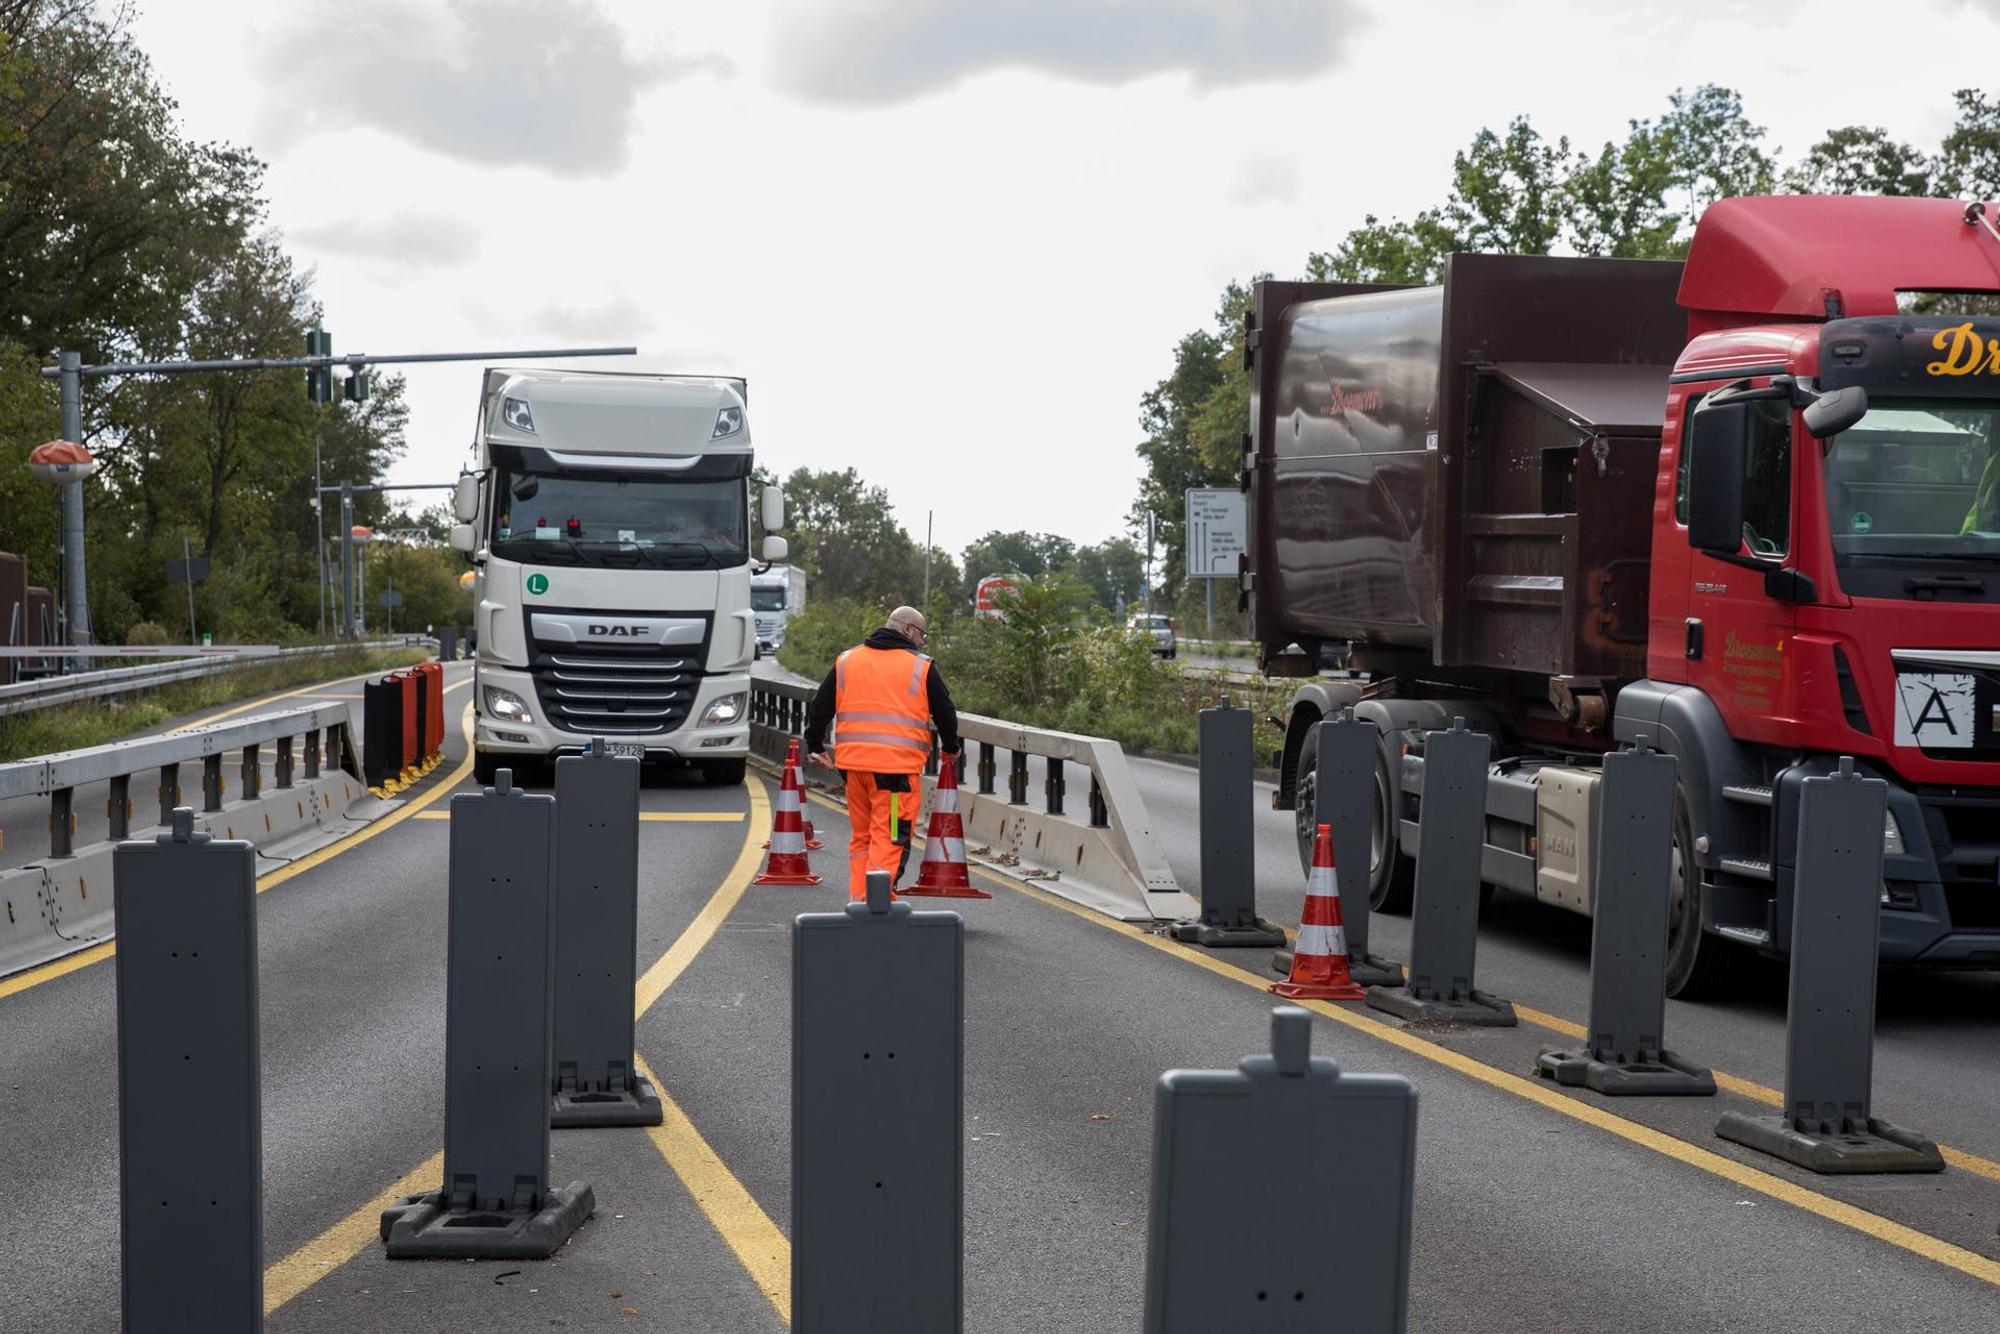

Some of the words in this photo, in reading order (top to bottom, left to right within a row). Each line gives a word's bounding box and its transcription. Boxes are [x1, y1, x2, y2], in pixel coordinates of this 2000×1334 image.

[532, 576, 542, 592] L
[588, 625, 649, 637] DAF
[1911, 687, 1958, 735] A
